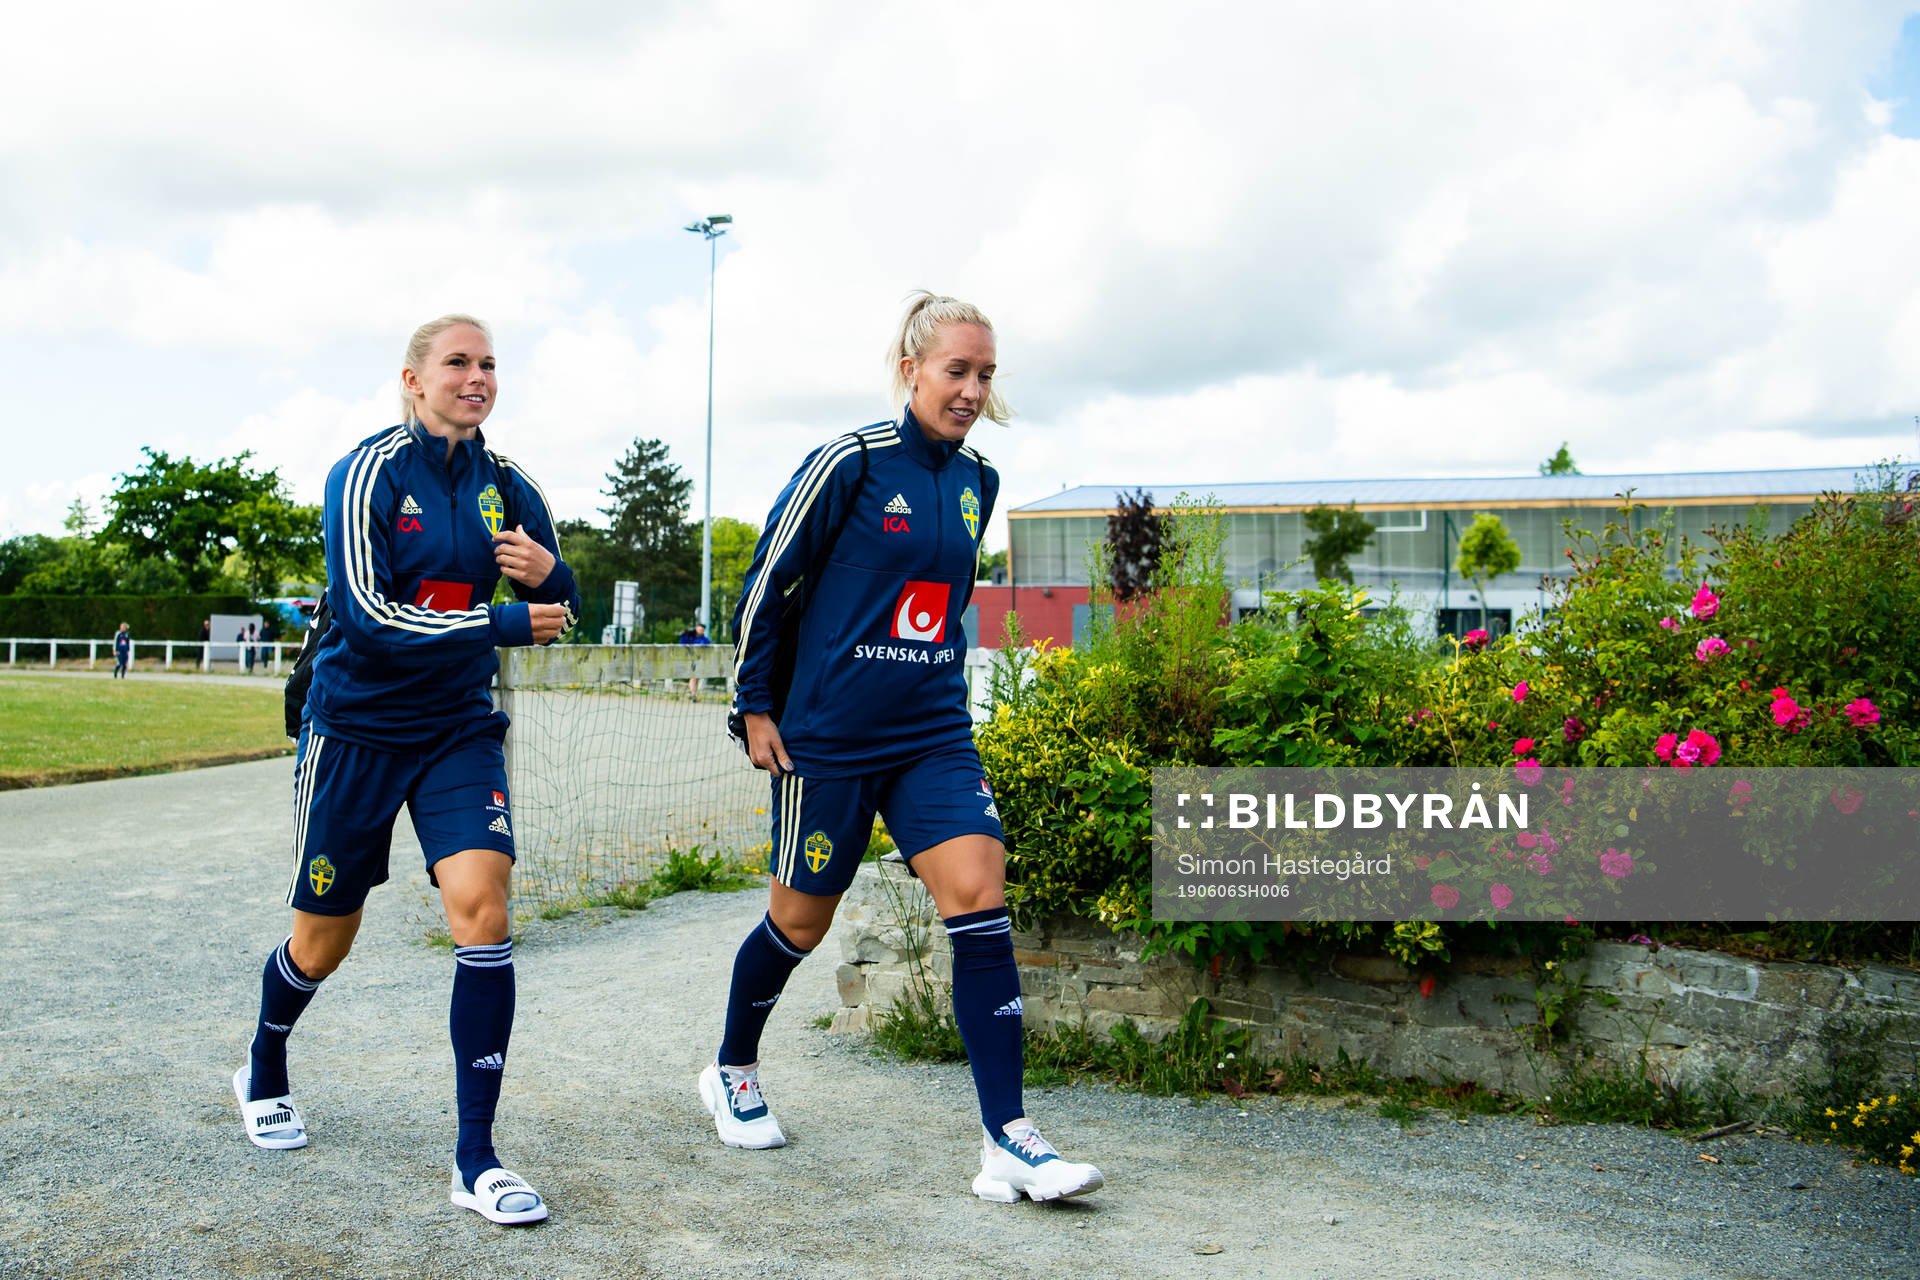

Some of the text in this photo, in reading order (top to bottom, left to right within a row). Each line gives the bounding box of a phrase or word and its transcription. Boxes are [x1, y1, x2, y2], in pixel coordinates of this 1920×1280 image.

[400, 506, 422, 514] adas
[884, 505, 912, 514] adidas
[397, 516, 424, 533] ICA
[883, 516, 911, 533] ICA
[854, 645, 930, 664] SVENSKA
[488, 824, 511, 837] adidas
[256, 1111, 292, 1127] PUMA
